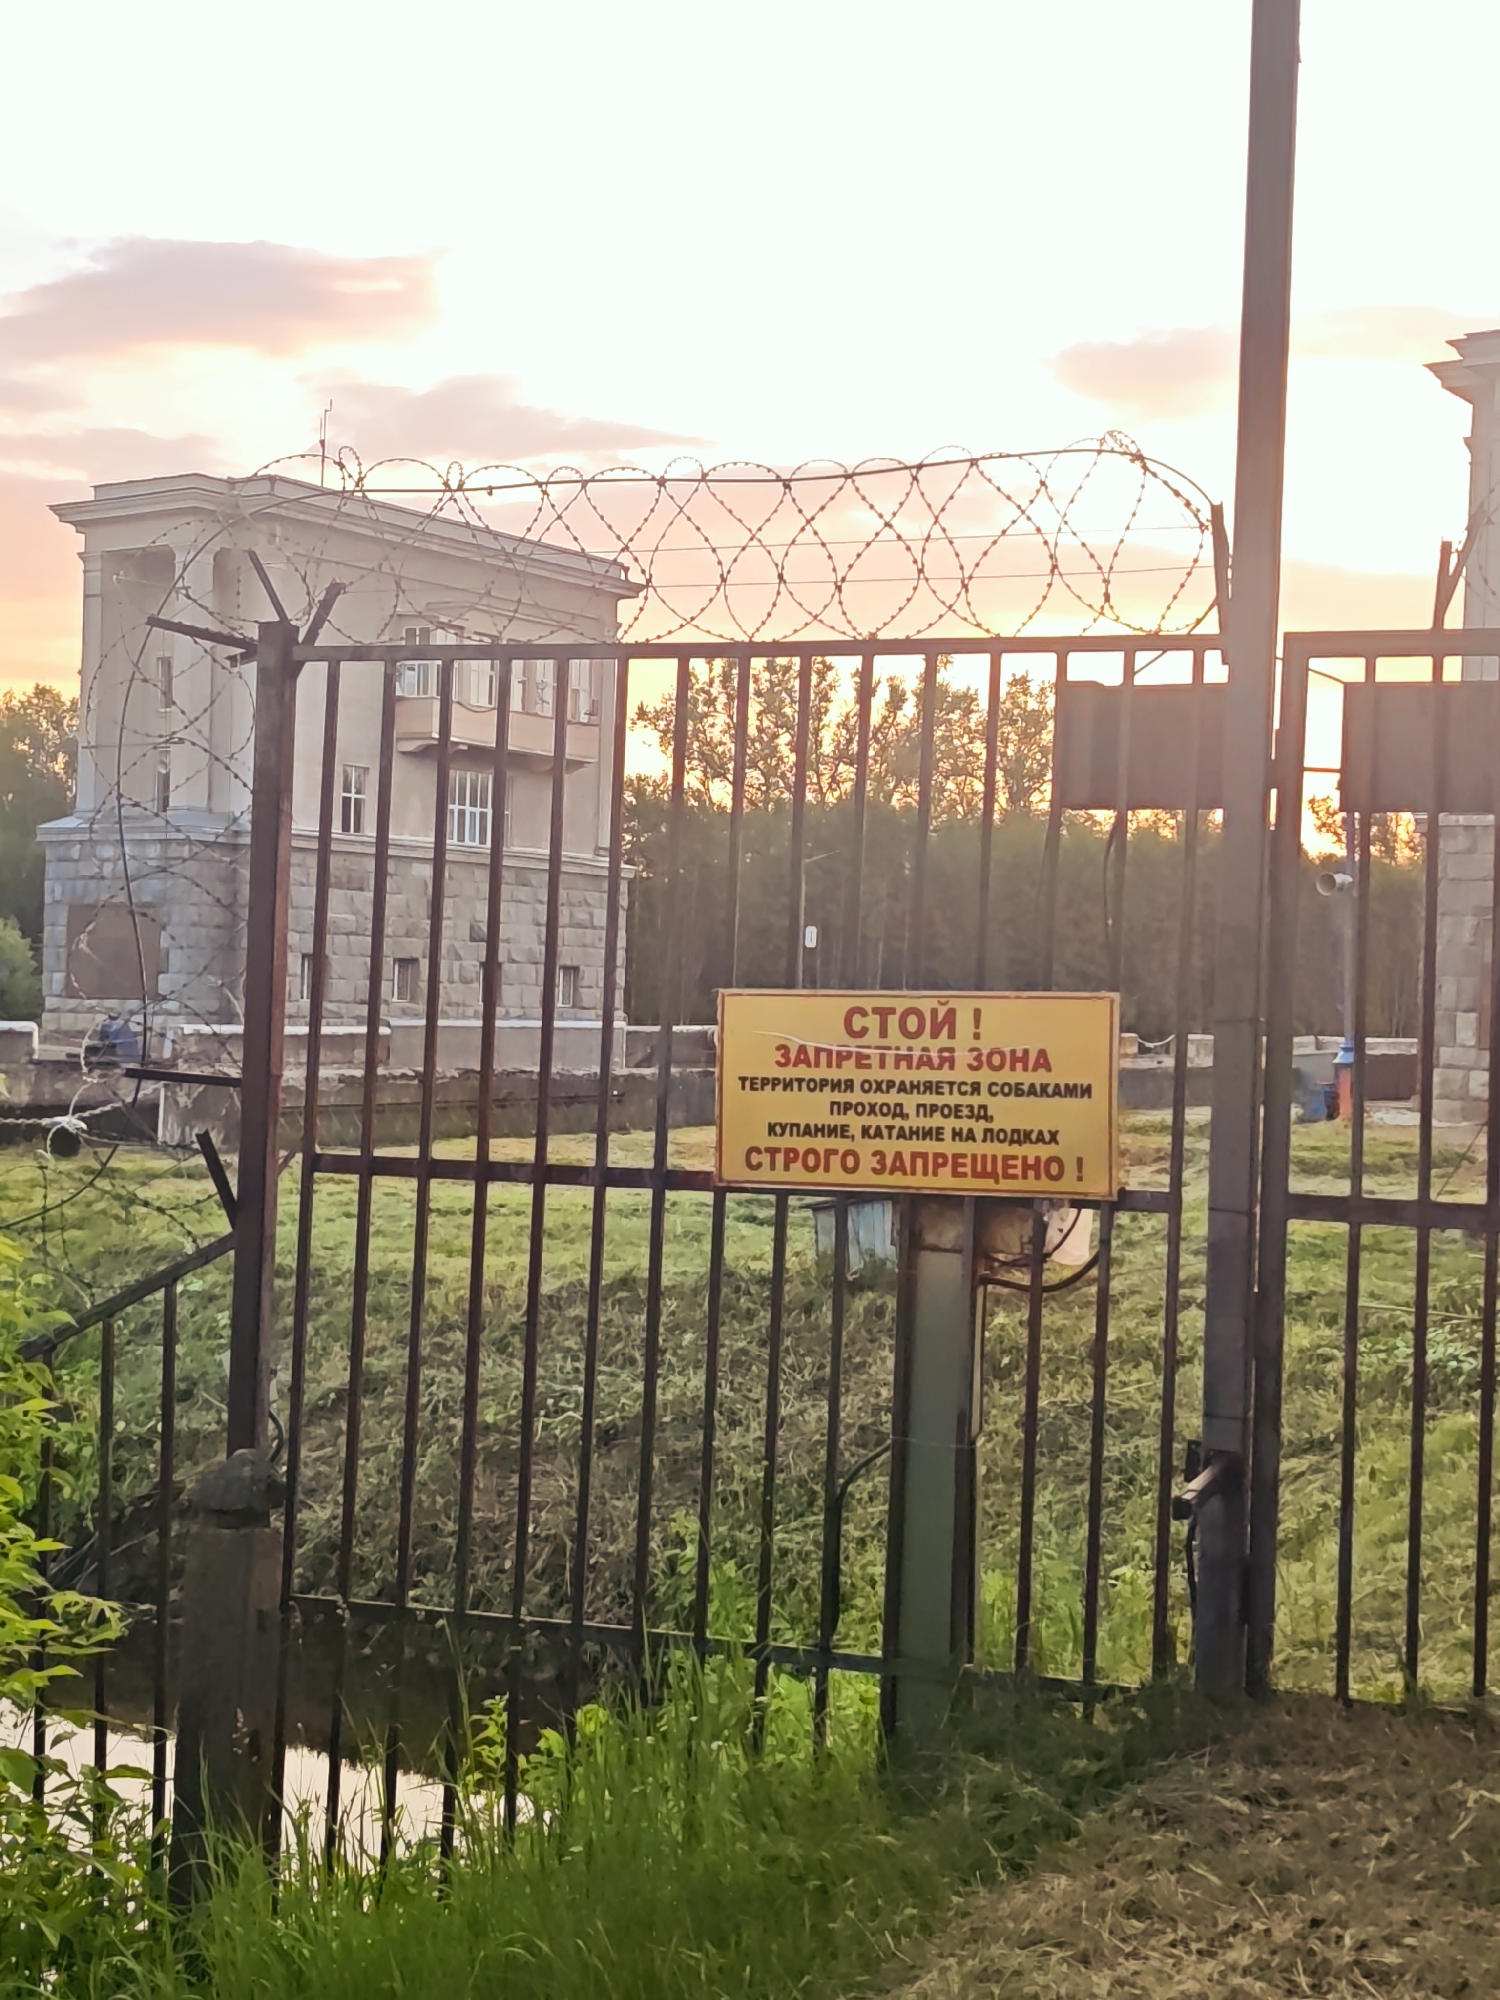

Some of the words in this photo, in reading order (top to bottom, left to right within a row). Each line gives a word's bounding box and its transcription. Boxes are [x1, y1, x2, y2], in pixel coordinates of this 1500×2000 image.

[843, 1000, 957, 1040] СТОЙ
[972, 1007, 983, 1041] !
[774, 1044, 956, 1071] ЗАПРЕТНАЯ
[966, 1047, 1053, 1073] ЗОНА
[738, 1076, 855, 1094] ТЕРРИТОРИЯ
[860, 1079, 981, 1096] ОХРАНЯЕТСЯ
[987, 1081, 1093, 1099] СОБАКАМИ
[829, 1101, 910, 1121] ПРОХОД,
[916, 1103, 994, 1123] ПРОЕЗД,
[767, 1122, 855, 1142] КУПАНИЕ,
[861, 1125, 945, 1142] КАТАНИЕ
[951, 1127, 977, 1142] НА
[981, 1128, 1060, 1147] ЛОДКАХ
[744, 1146, 861, 1175] СТРОГО
[870, 1149, 1065, 1185] ЗАПРЕЩЕНО
[1075, 1156, 1084, 1183] !
